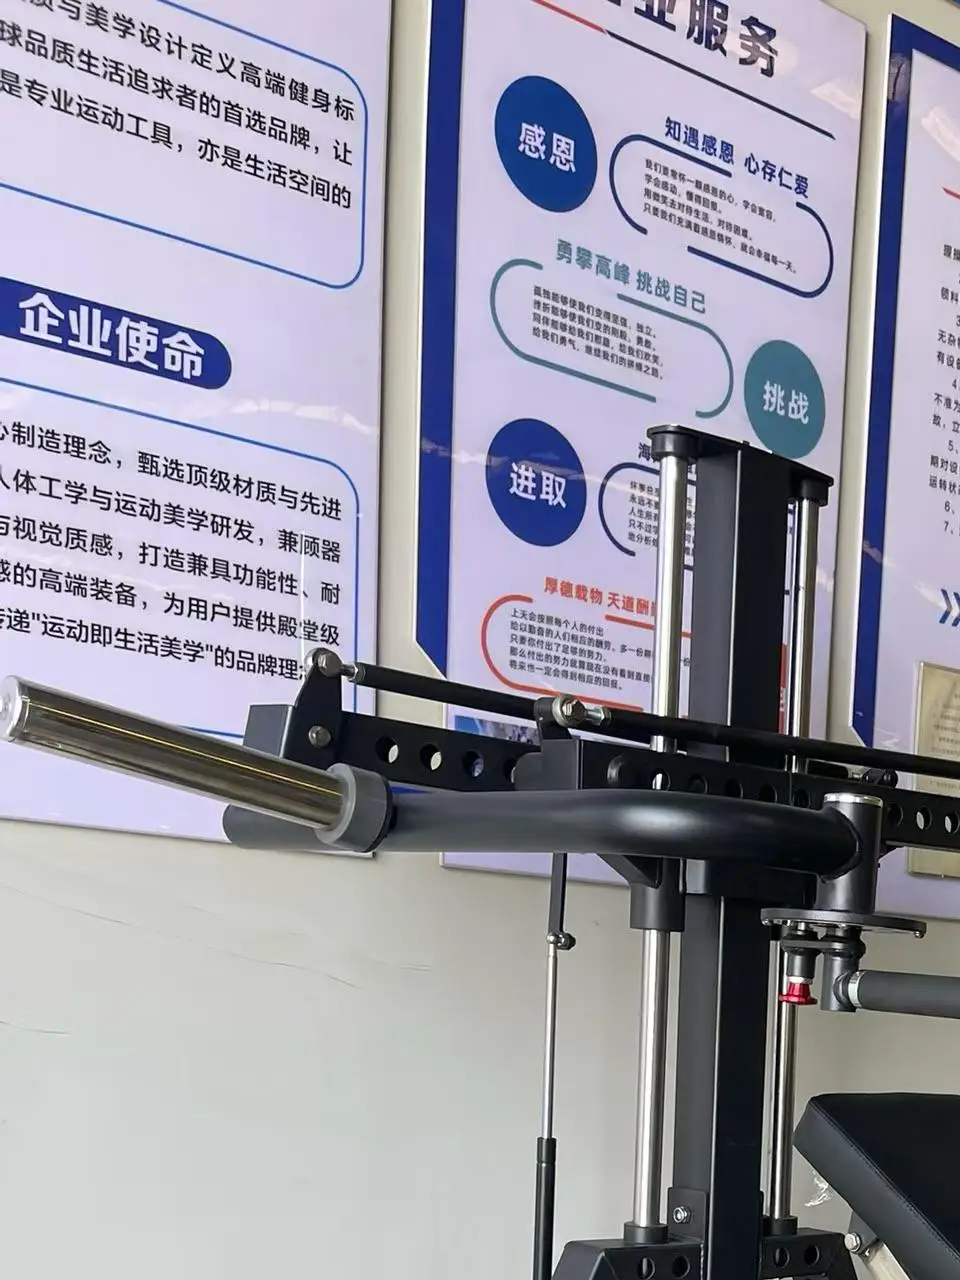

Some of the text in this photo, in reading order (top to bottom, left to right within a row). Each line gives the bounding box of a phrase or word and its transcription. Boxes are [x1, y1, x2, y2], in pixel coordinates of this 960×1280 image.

[0, 19, 353, 167] 球品质生活追求者的首选品牌，让
[0, 68, 352, 210] 是专业运动工具，亦是生活空间的
[518, 121, 576, 173] 感恩
[665, 117, 809, 199] 知遇感恩 心存仁爱
[556, 239, 706, 315] 勇攀高峰 挑战自己
[18, 292, 206, 380] 企业使命
[763, 383, 809, 425] 挑战
[509, 462, 567, 509] 进取
[544, 576, 603, 606] 厚德载物
